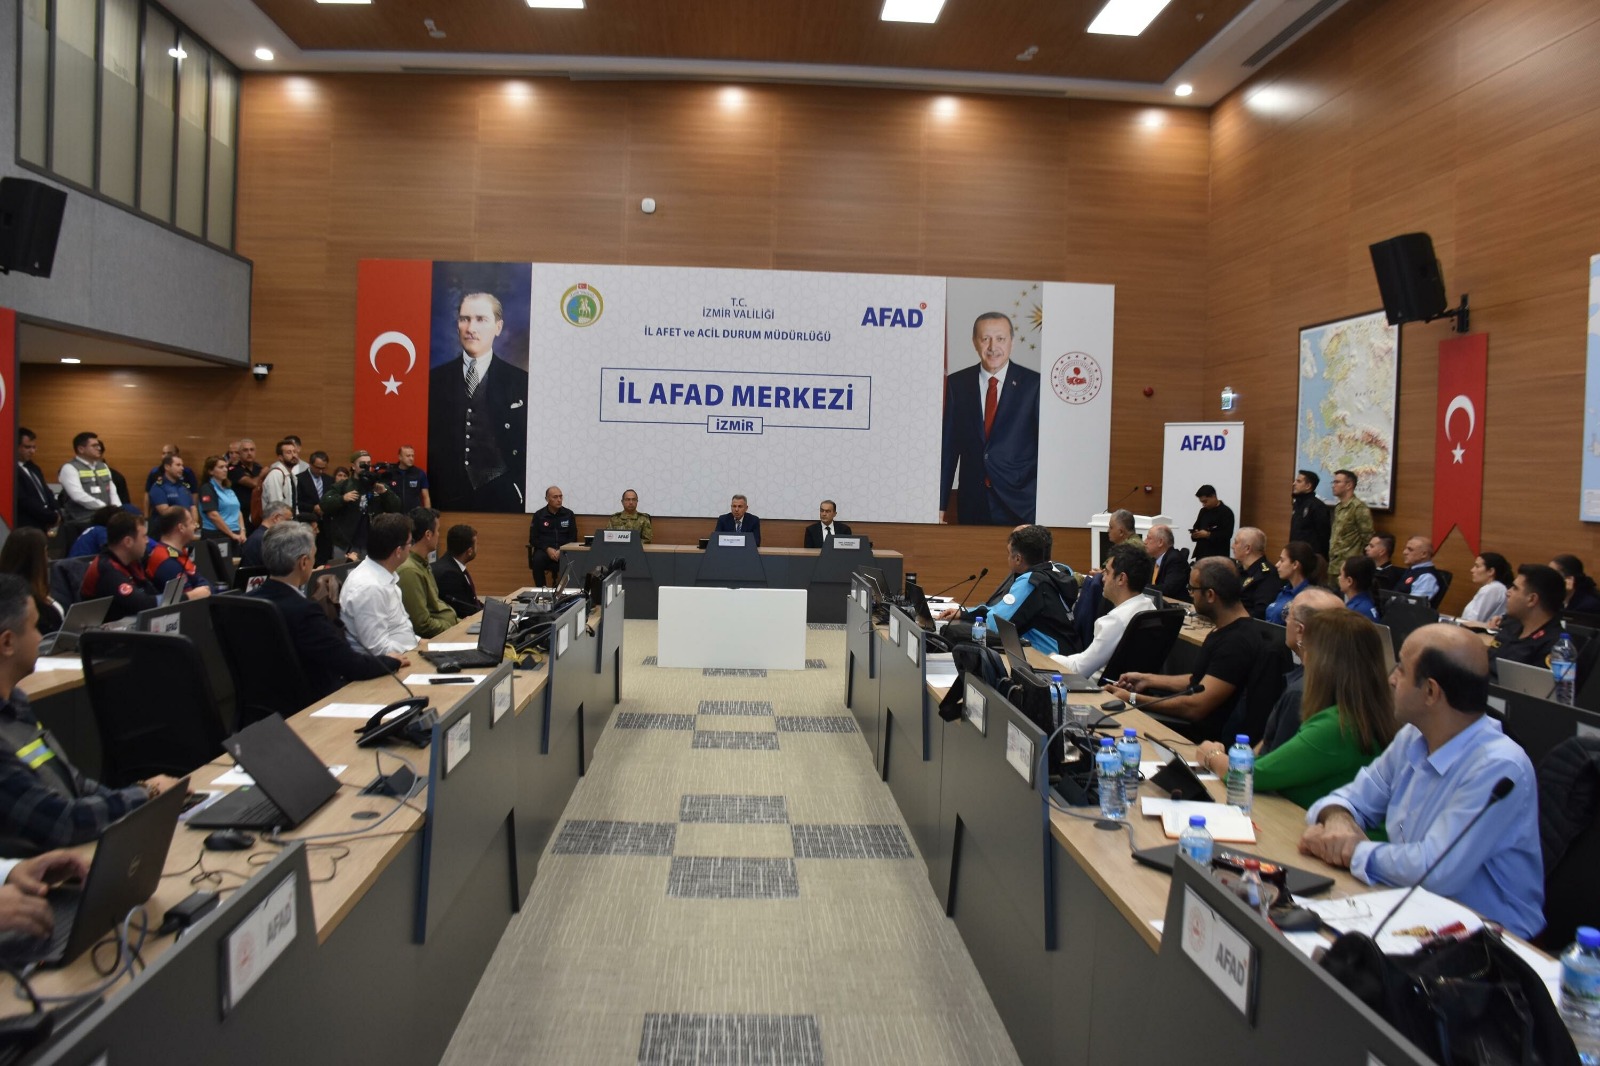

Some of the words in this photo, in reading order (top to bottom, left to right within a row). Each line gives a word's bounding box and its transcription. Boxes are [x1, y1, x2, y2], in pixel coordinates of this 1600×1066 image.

[731, 297, 747, 307] T.C.
[702, 306, 731, 318] İZMİR
[733, 308, 775, 320] VALİLİĞİ
[861, 306, 924, 328] AFAD
[644, 325, 653, 336] İL
[656, 327, 681, 337] AFET
[683, 330, 695, 338] ve
[697, 327, 720, 338] ACİL
[722, 329, 761, 340] DURUM
[764, 329, 831, 342] MÜDÜRLÜĞÜ
[618, 376, 641, 404] İL
[648, 382, 724, 406] AFAD
[731, 383, 853, 411] MERKEZİ
[715, 418, 754, 432] İZMİR
[1180, 435, 1226, 451] AFAD
[267, 902, 292, 945] AFAD
[1215, 942, 1245, 986] AFAD
